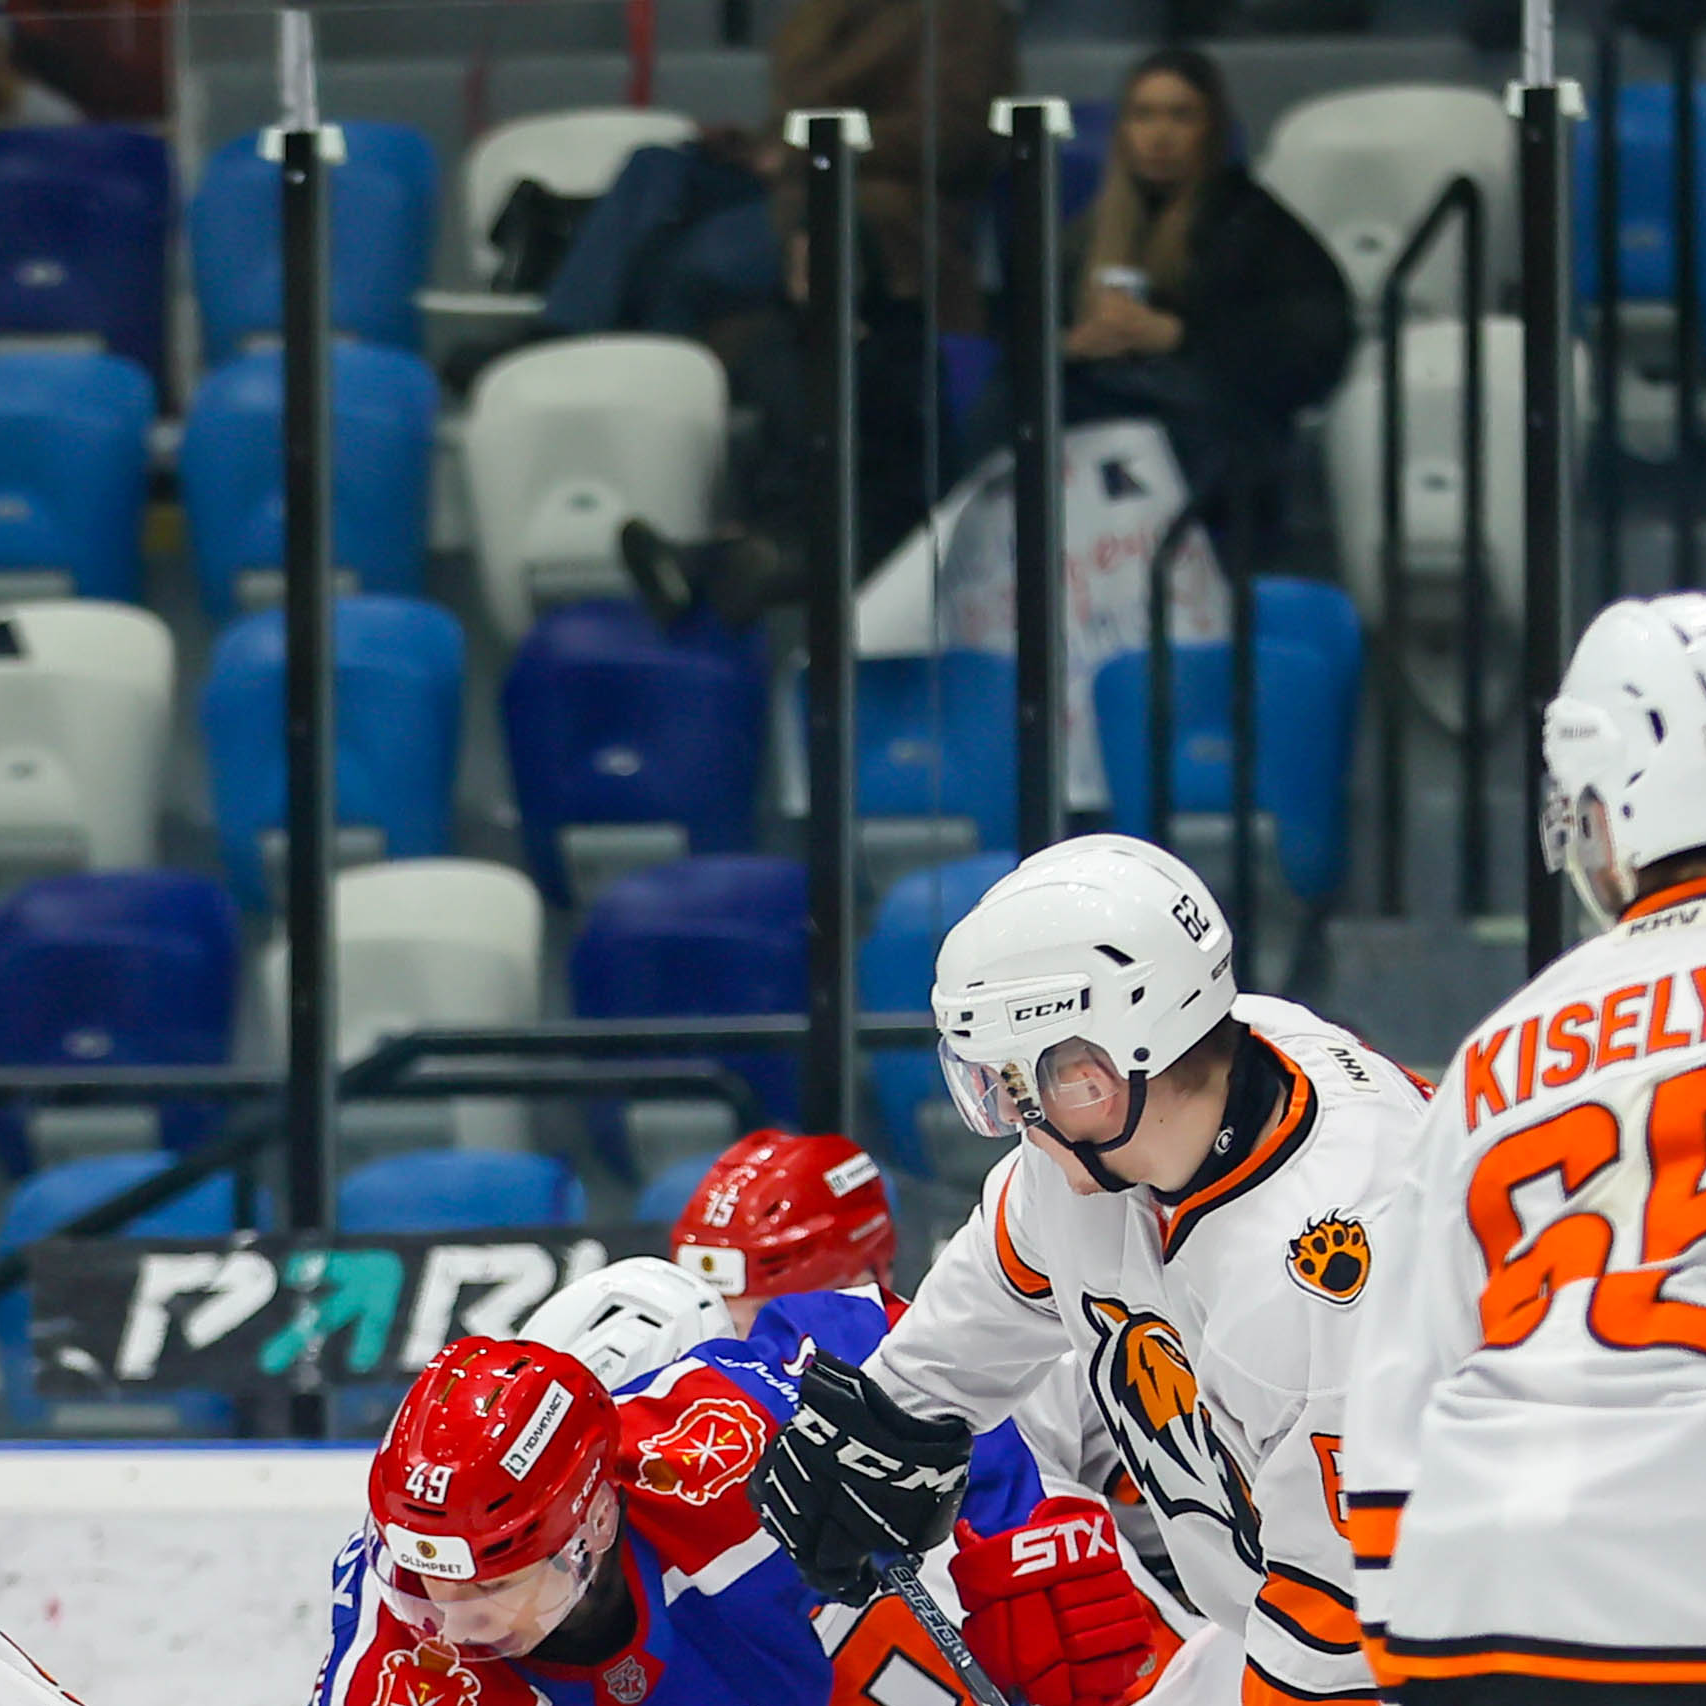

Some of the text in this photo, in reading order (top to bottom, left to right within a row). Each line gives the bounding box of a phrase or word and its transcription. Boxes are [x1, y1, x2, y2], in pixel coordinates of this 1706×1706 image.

[1171, 893, 1211, 943] 62
[1014, 998, 1076, 1022] CCM
[793, 1404, 972, 1494] CCM
[405, 1462, 454, 1505] 49
[1010, 1514, 1116, 1579] STX
